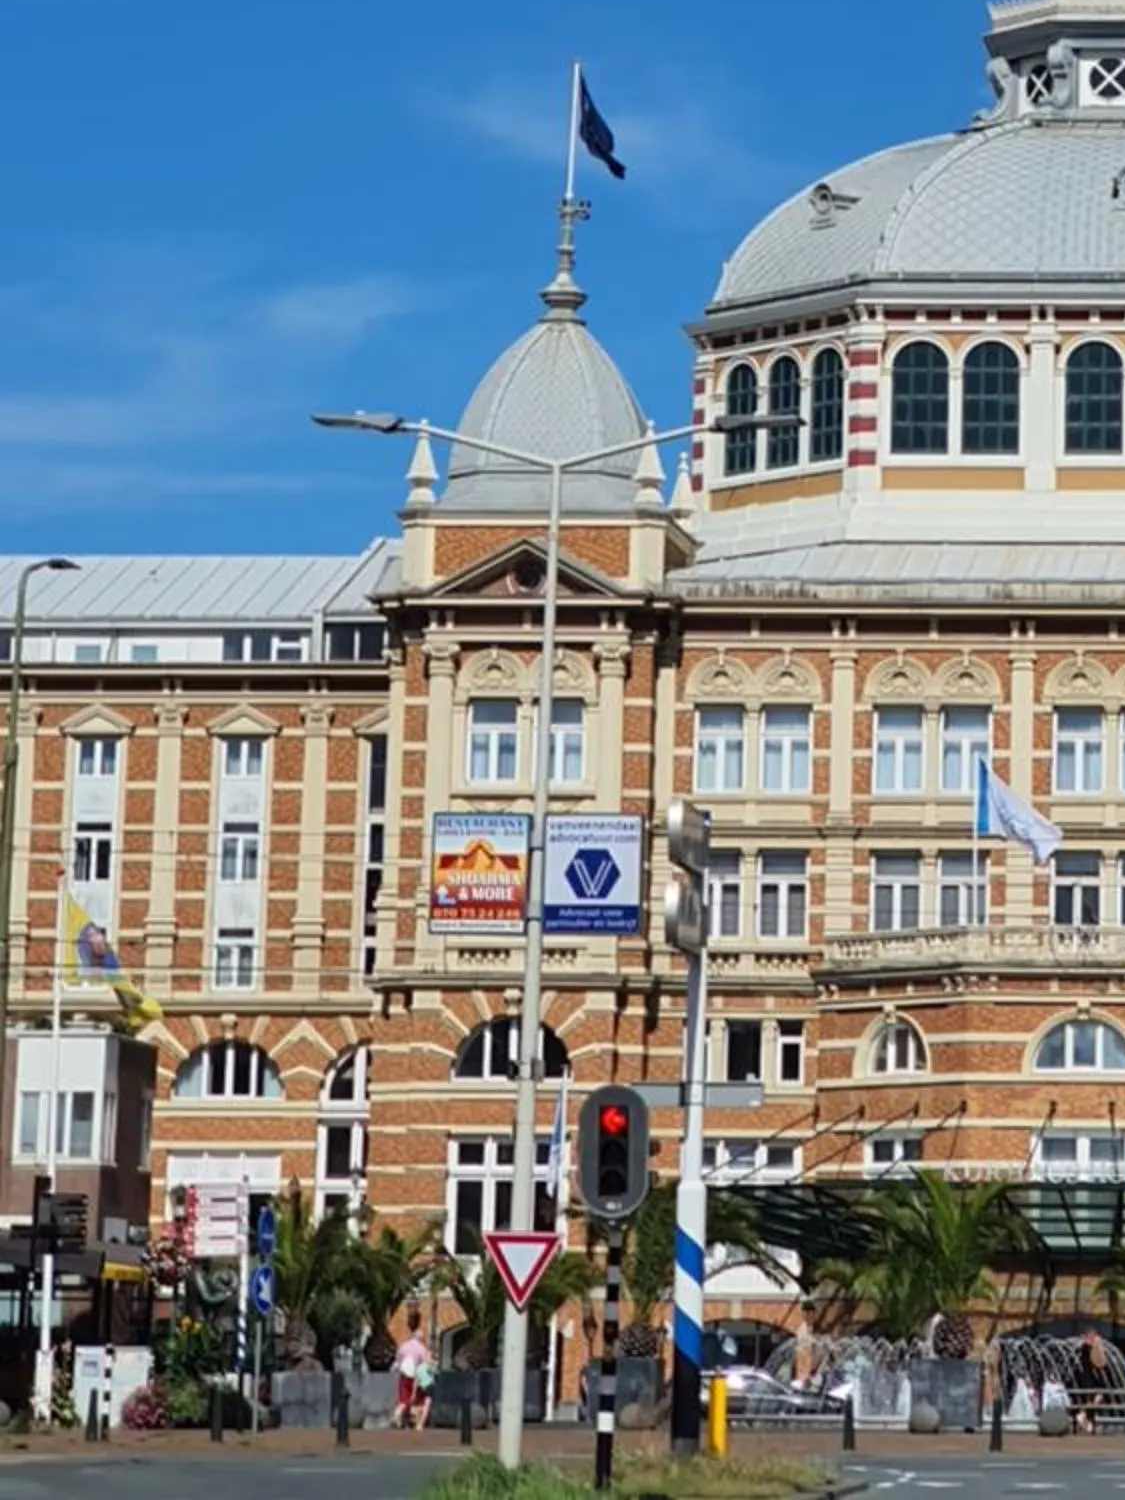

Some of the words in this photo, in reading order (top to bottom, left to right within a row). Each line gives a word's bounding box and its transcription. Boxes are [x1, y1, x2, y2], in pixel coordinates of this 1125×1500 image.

[448, 871, 520, 885] SHOARMA
[457, 886, 469, 900] &
[472, 886, 516, 901] MORE
